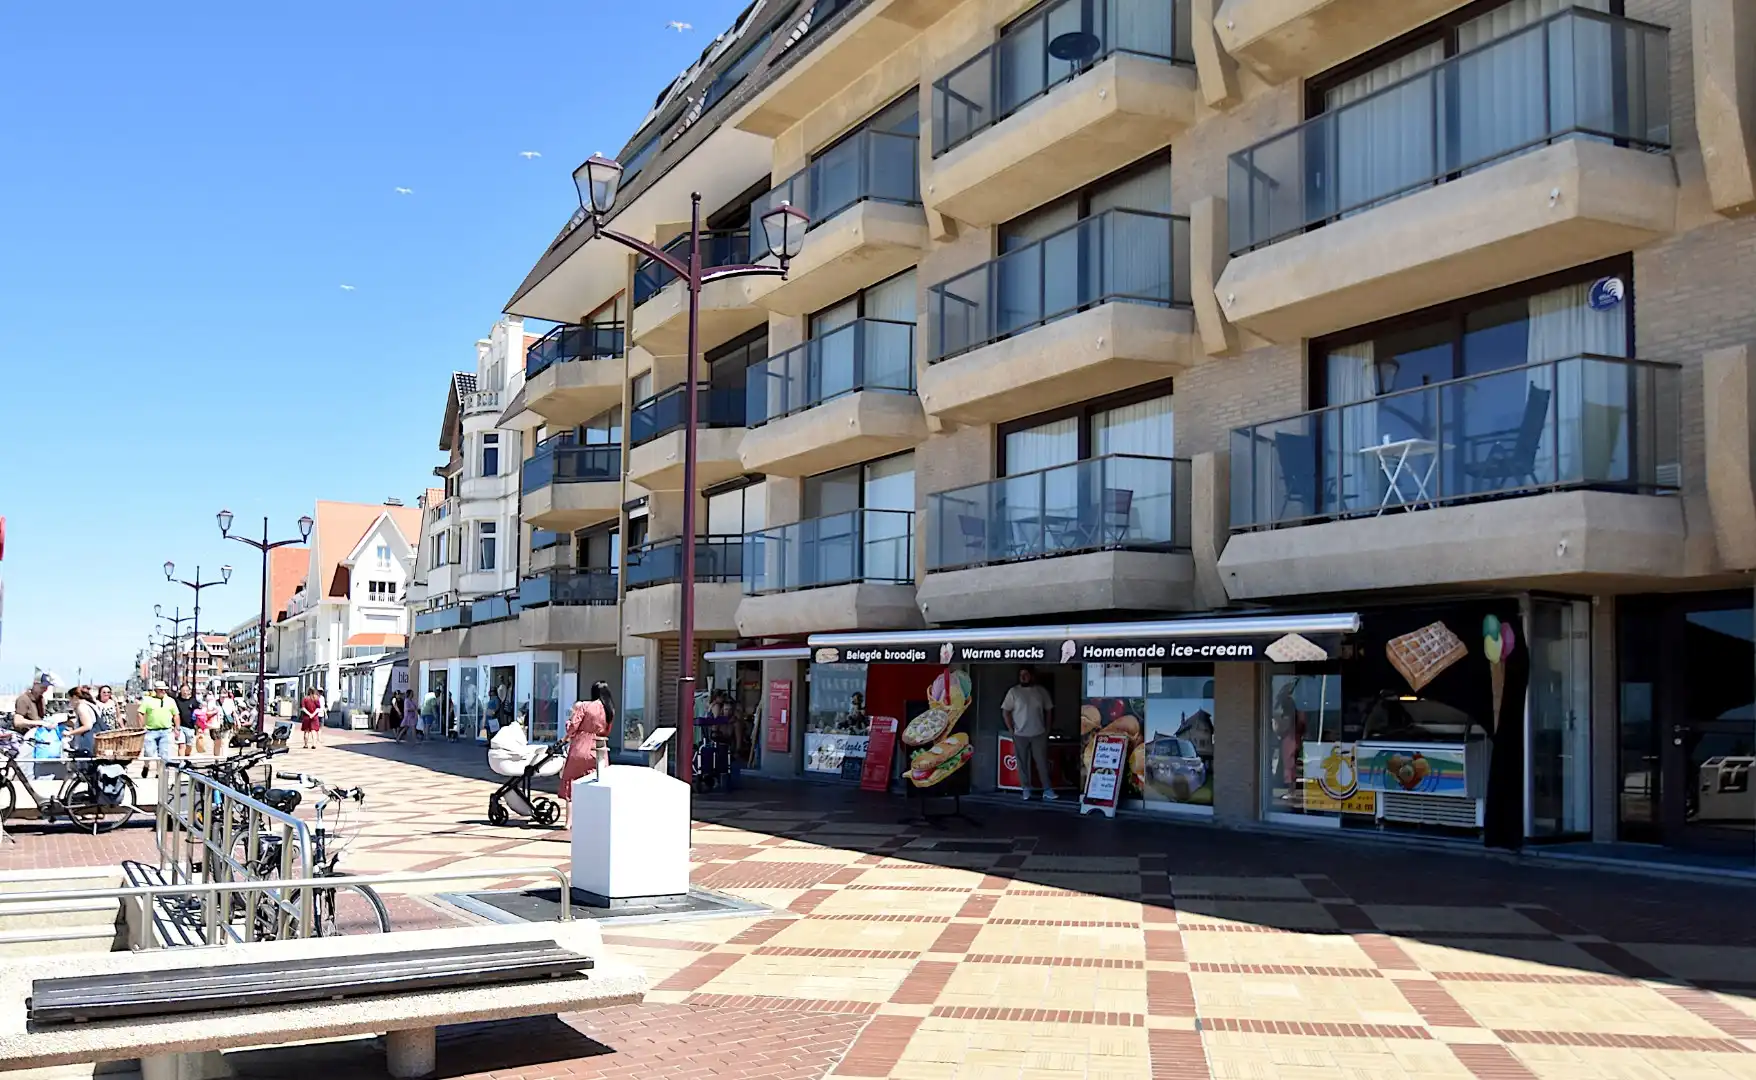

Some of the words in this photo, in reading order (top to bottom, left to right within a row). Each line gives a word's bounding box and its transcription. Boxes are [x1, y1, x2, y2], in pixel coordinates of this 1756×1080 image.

[846, 650, 882, 662] Belegde
[885, 648, 926, 662] broodjes
[962, 648, 1001, 659] Warme
[1005, 646, 1045, 659] snacks
[1083, 645, 1166, 658] Homemade
[1171, 643, 1253, 657] ice-cream
